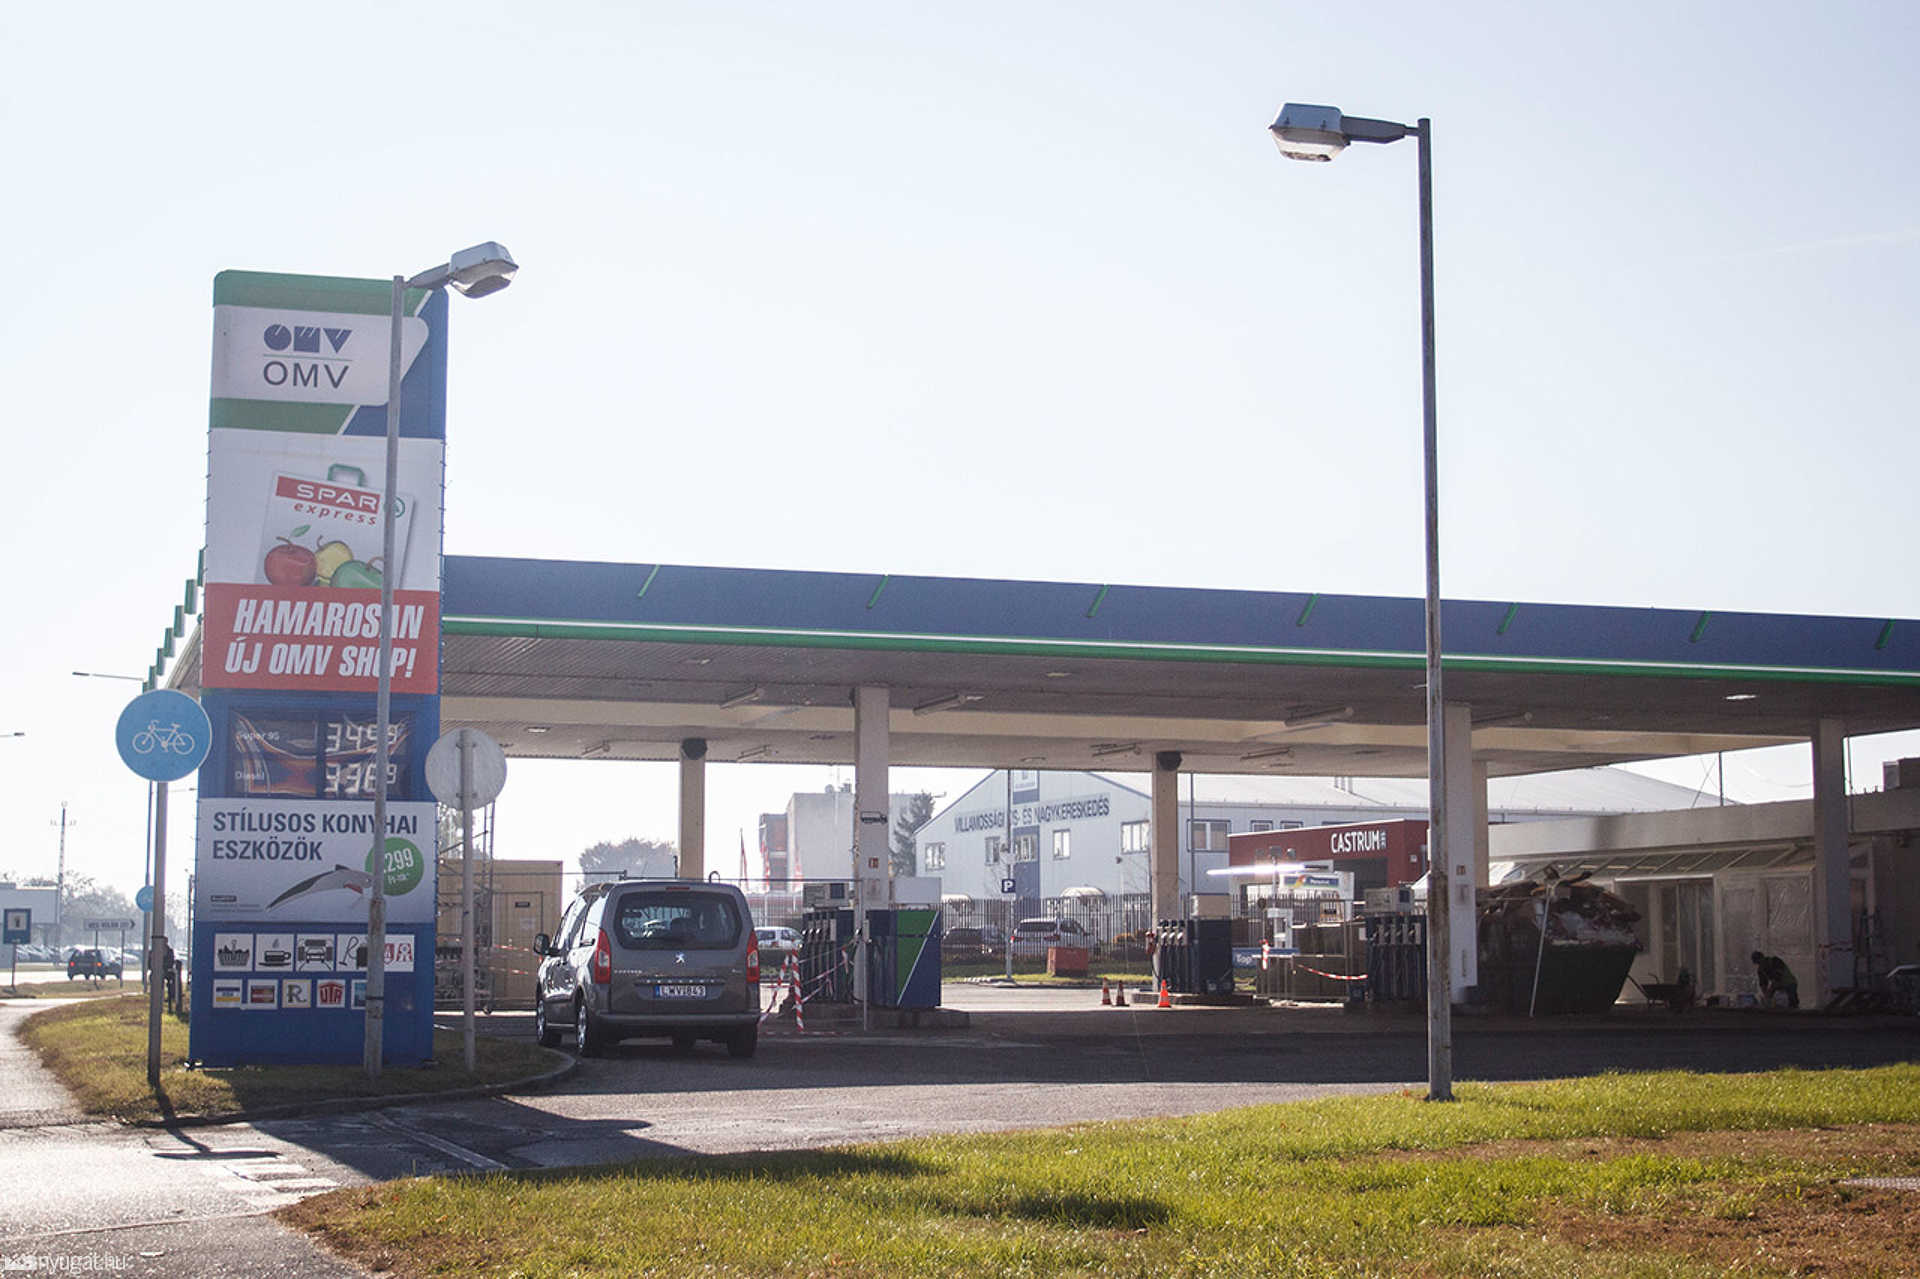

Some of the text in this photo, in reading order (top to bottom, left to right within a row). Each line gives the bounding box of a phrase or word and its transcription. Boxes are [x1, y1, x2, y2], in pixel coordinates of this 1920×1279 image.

[263, 361, 349, 389] OMV
[296, 483, 377, 512] SPAR
[293, 501, 377, 526] express
[224, 636, 263, 674] ÚJ
[268, 643, 333, 676] OMV
[213, 807, 417, 835] STÍLUSOS KONYHAI
[212, 836, 323, 861] ESZKÖZÖK
[1331, 829, 1380, 853] CASTRUM
[1004, 880, 1013, 892] P
